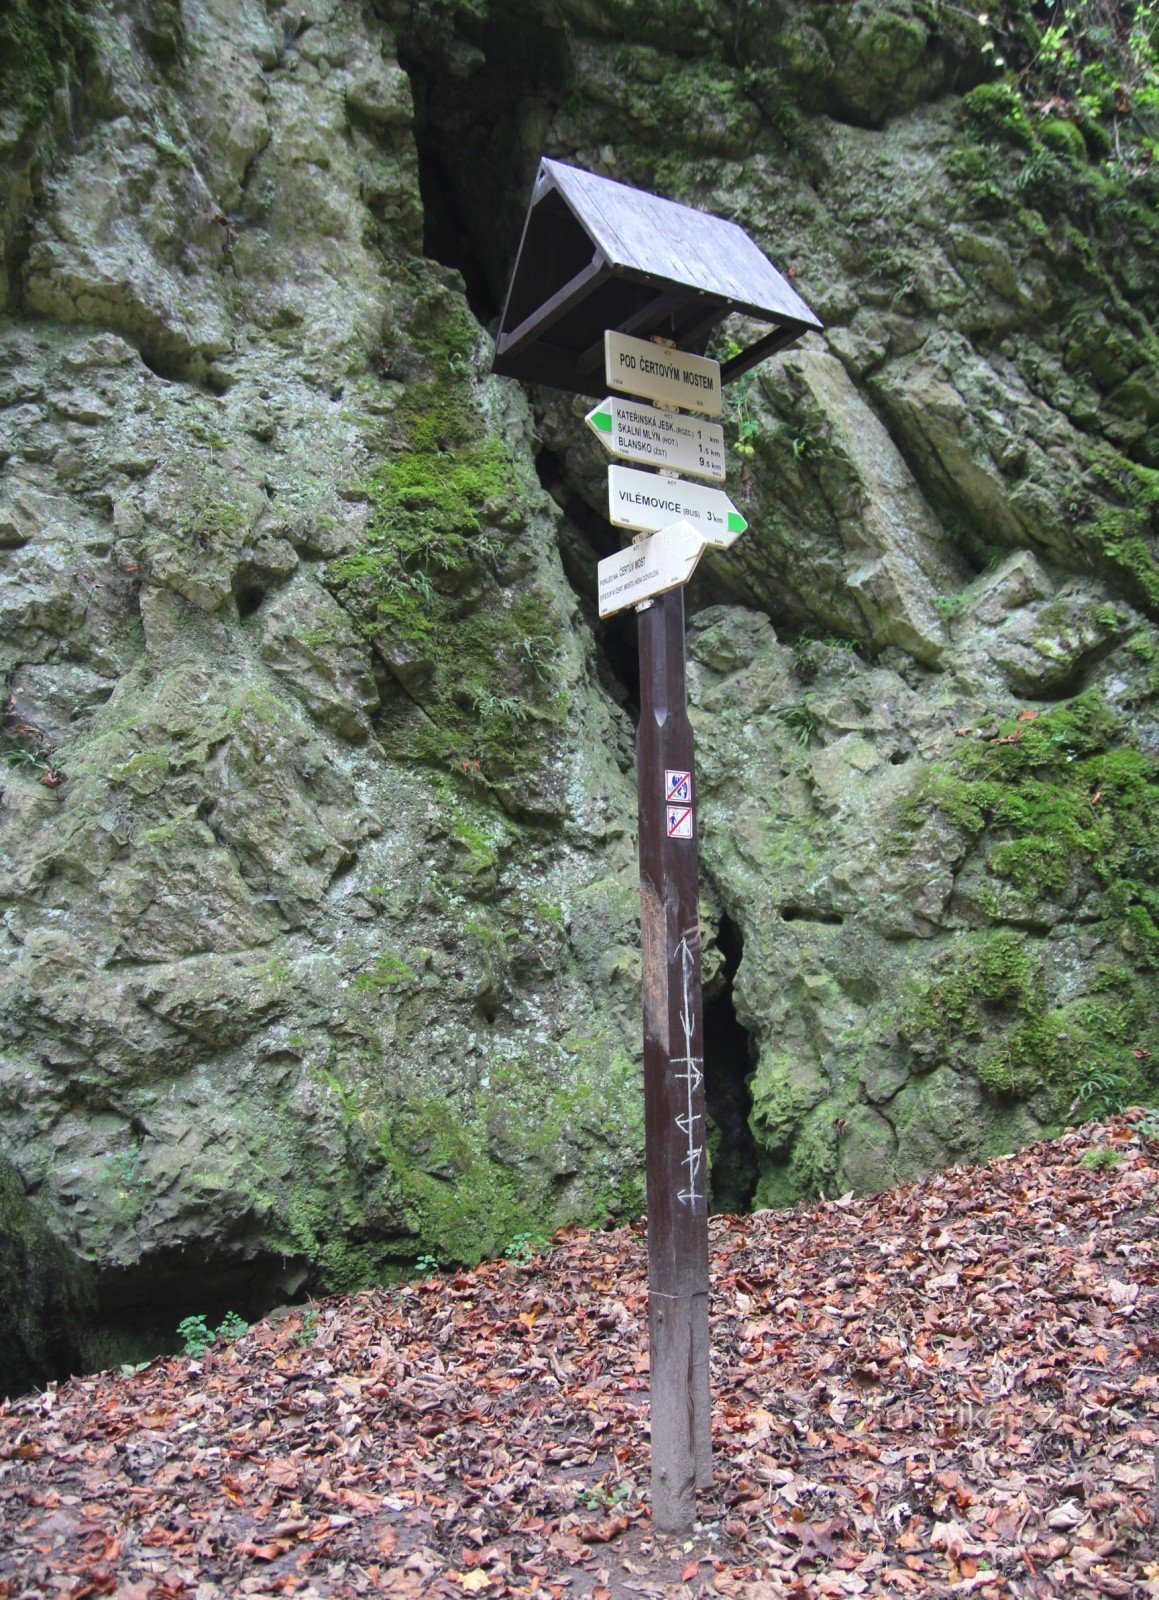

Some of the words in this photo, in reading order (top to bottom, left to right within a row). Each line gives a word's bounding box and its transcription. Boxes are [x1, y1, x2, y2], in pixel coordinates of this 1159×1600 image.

[619, 353, 636, 369] POD
[640, 355, 680, 381] ČERTOVÝM
[683, 370, 714, 391] MOSTEM
[616, 409, 657, 428] KATEŘINSKÁ
[658, 419, 675, 433] JESK.
[697, 430, 702, 440] 1
[709, 435, 720, 444] km
[617, 422, 642, 438] SKALNÍ
[642, 428, 661, 442] MLÝN
[710, 449, 721, 458] km
[618, 436, 652, 453] BLANSKO
[711, 462, 722, 471] km
[618, 490, 682, 514] VILÉMOVICE
[683, 507, 701, 520] (BUS)
[706, 511, 713, 521] 3
[713, 513, 724, 524] km
